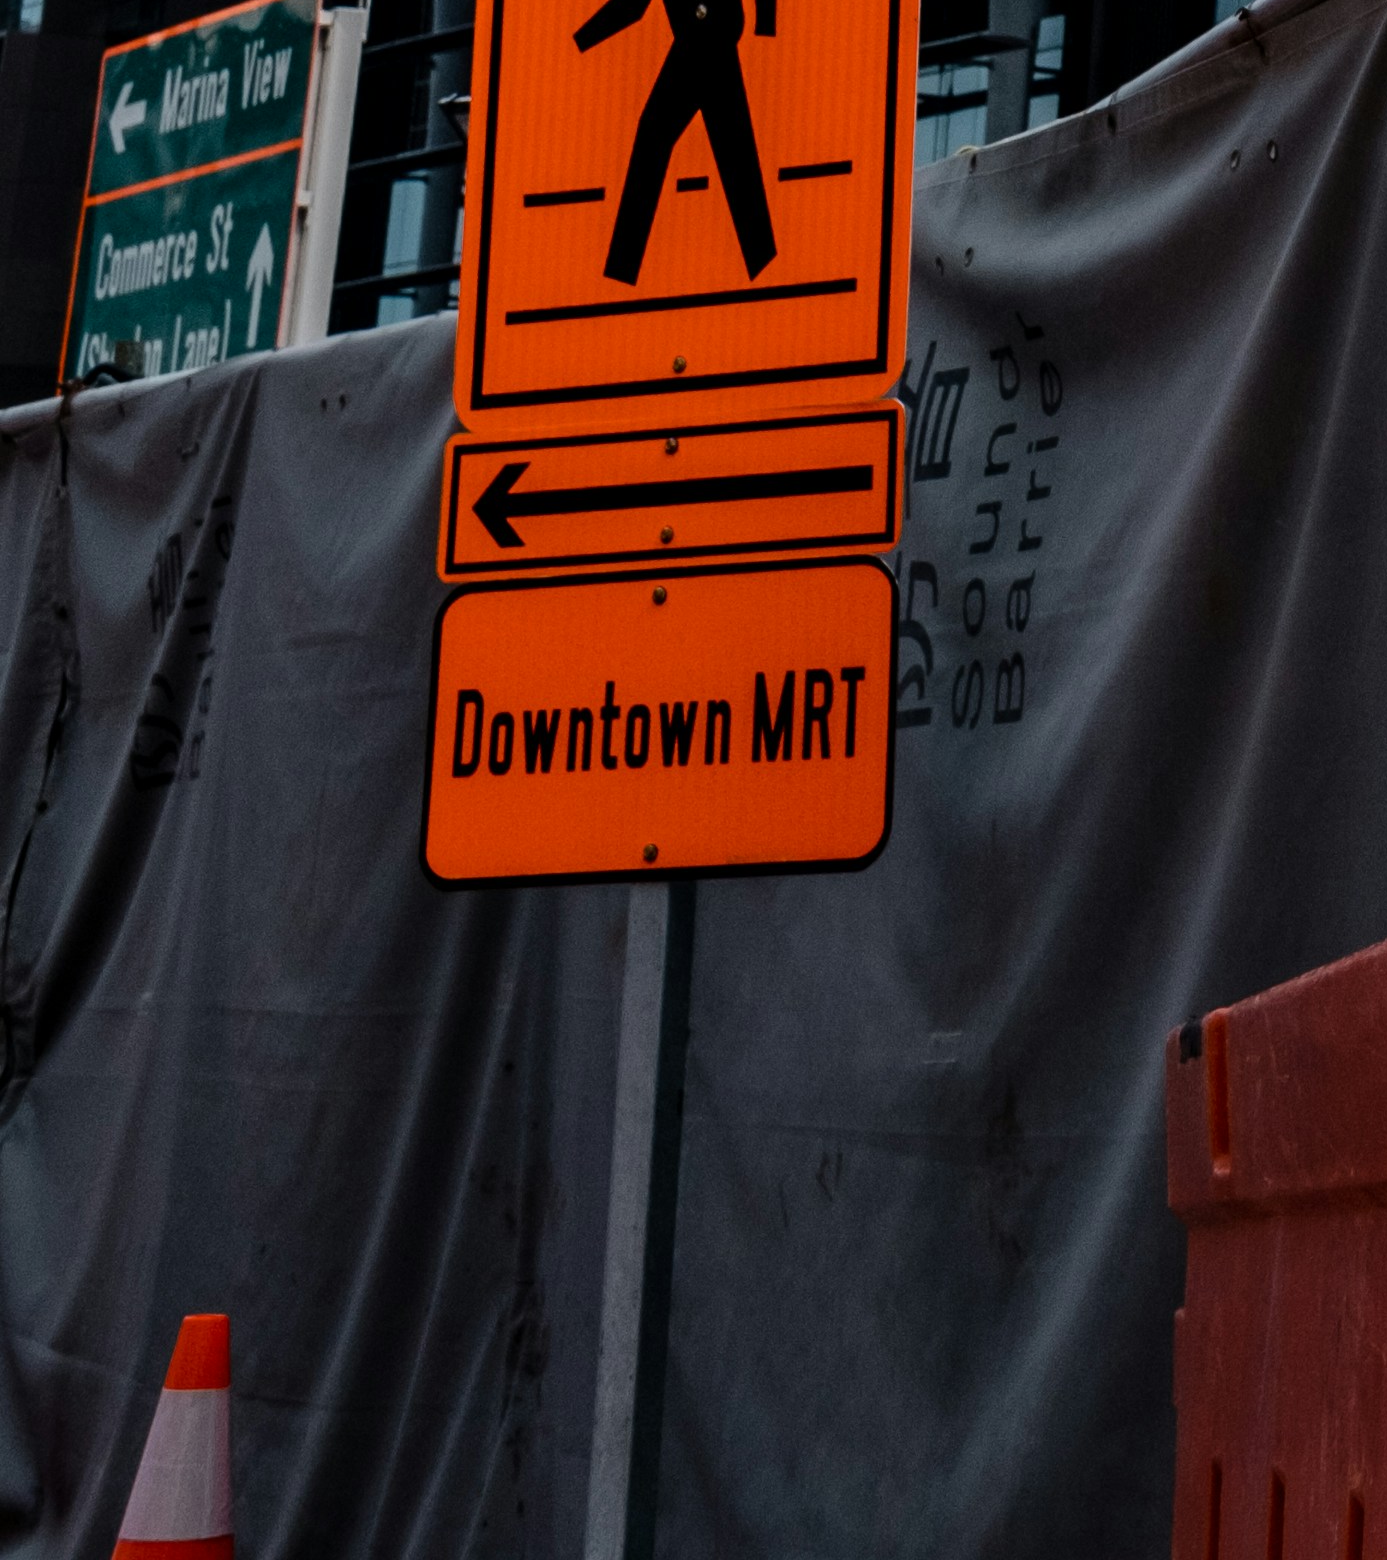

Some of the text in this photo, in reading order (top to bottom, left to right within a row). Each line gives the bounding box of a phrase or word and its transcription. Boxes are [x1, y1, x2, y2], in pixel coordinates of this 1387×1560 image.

[158, 38, 293, 136] Marina View
[95, 201, 234, 301] Commerce St
[951, 345, 1020, 729] Sound
[993, 311, 1063, 725] Barrier
[452, 666, 866, 778] Downtown MRT
